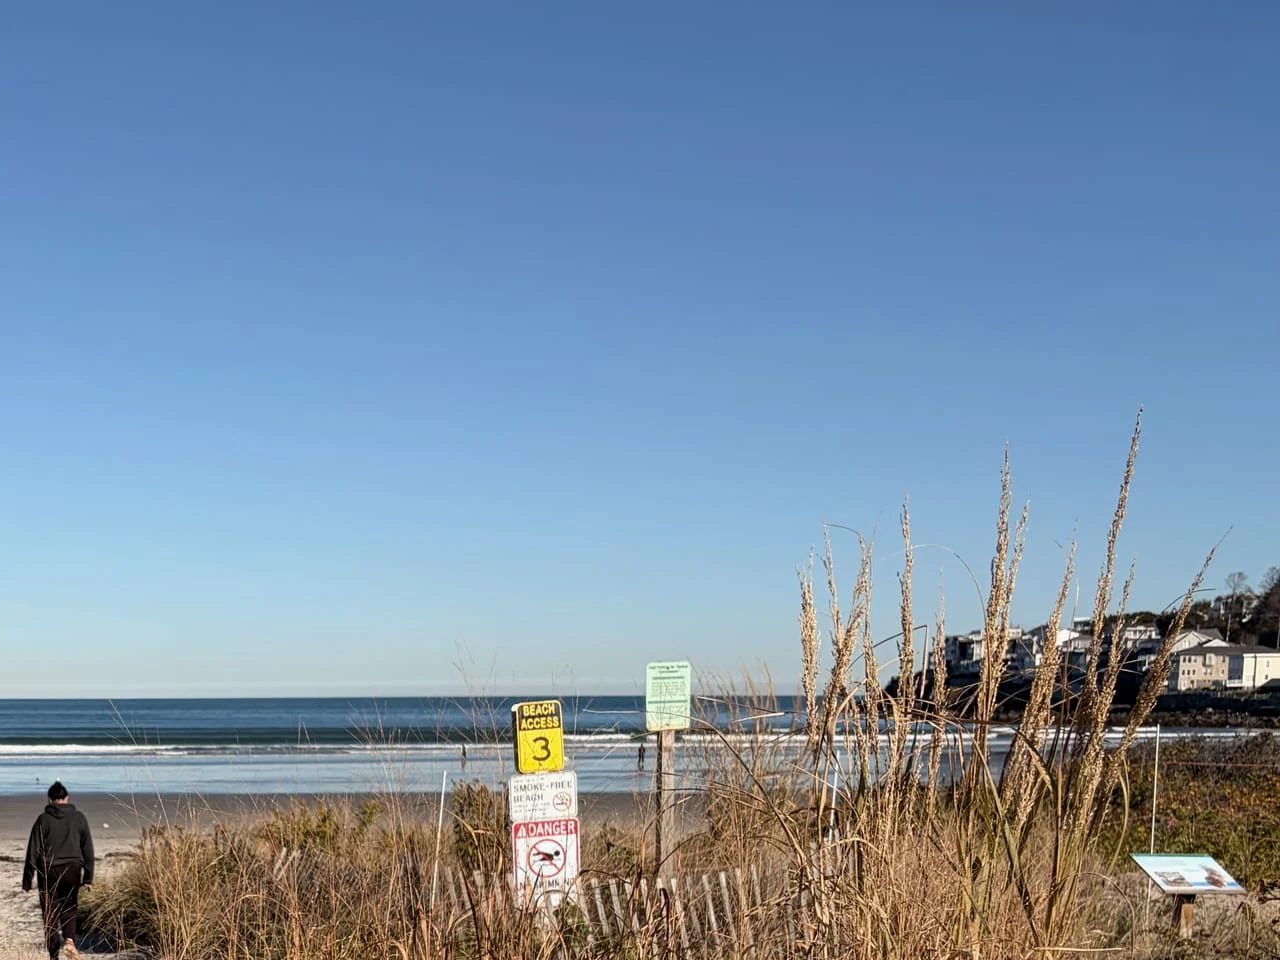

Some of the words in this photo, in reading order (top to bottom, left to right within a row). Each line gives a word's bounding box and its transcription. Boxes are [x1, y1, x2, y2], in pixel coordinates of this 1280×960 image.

[523, 703, 555, 717] BEACH
[521, 716, 559, 729] ACCESS
[533, 736, 551, 761] 3
[513, 781, 572, 793] SMOKE-FREE
[513, 793, 544, 803] BEACH
[528, 821, 575, 837] DANGER
